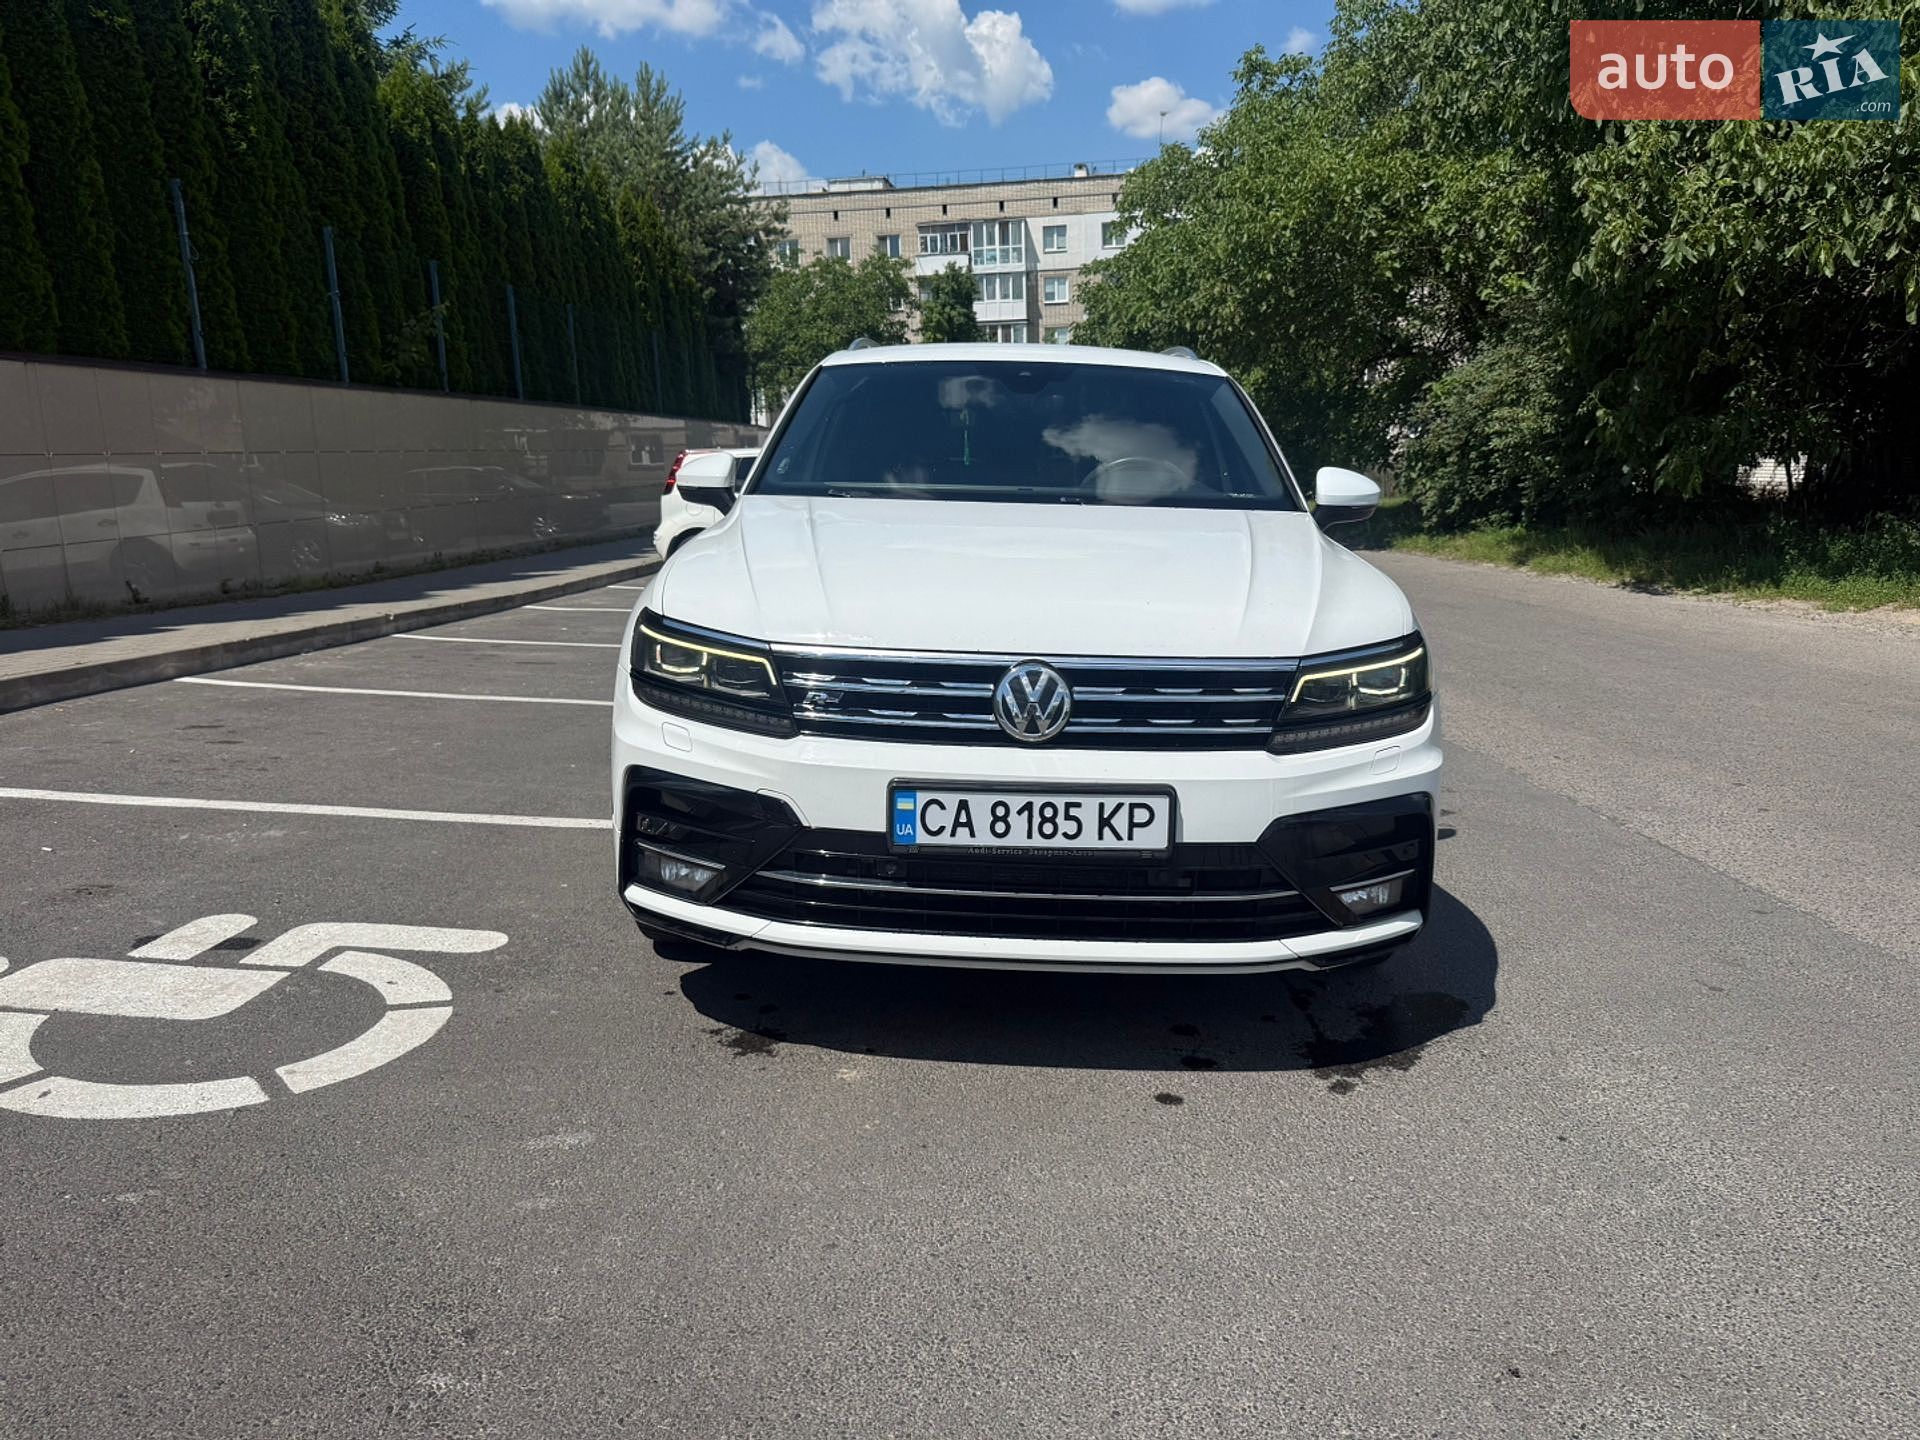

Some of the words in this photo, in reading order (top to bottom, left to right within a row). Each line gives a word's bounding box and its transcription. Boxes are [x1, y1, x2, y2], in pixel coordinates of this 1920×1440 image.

[896, 823, 914, 836] UA
[919, 798, 976, 838] CA
[989, 800, 1083, 840] 8185
[1097, 801, 1155, 842] KP
